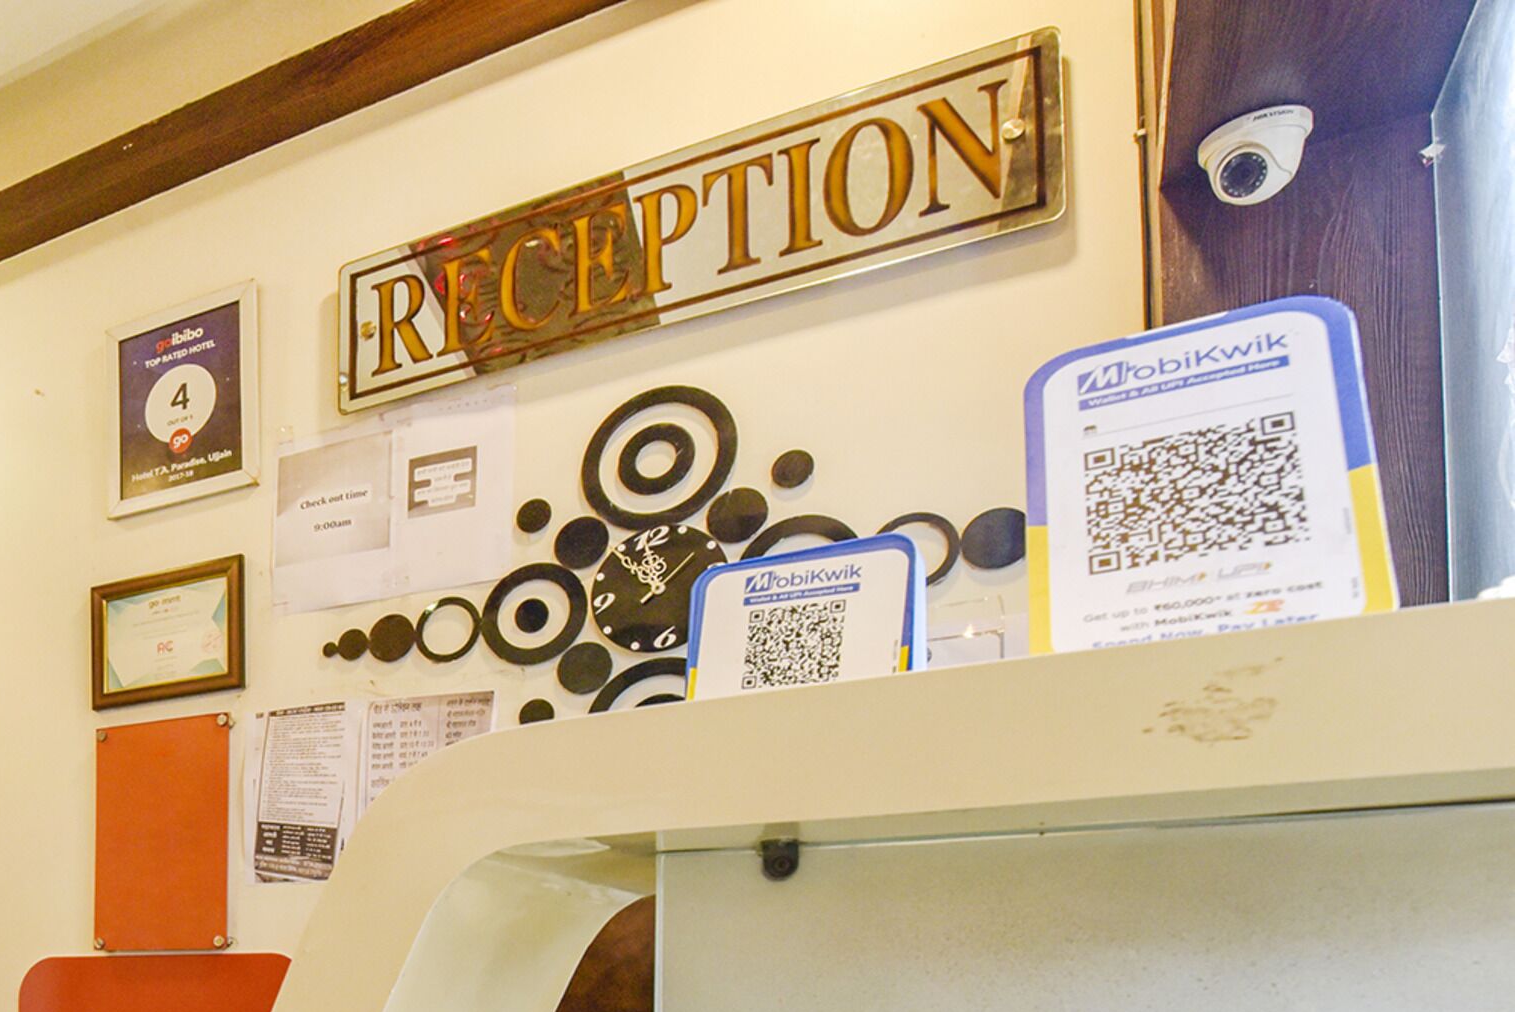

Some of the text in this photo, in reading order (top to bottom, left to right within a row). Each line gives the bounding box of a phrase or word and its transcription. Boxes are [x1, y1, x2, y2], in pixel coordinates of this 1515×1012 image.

[370, 80, 1009, 376] RECEPTION
[145, 339, 216, 368] TOP RATED HOTEL
[156, 327, 204, 353] goibibo
[1077, 333, 1289, 396] MobiKwik
[170, 382, 190, 410] 4
[1087, 389, 1127, 407] Wallet
[1186, 366, 1247, 385] Accepted
[172, 434, 189, 449] go
[131, 469, 155, 482] Hotel
[208, 448, 232, 462] Ujjain
[300, 488, 368, 510] Check out time
[313, 518, 352, 532] 9:00am
[633, 525, 670, 551] 12
[744, 564, 862, 595] MobiKwik
[594, 592, 616, 615] 9
[653, 625, 677, 648] 6
